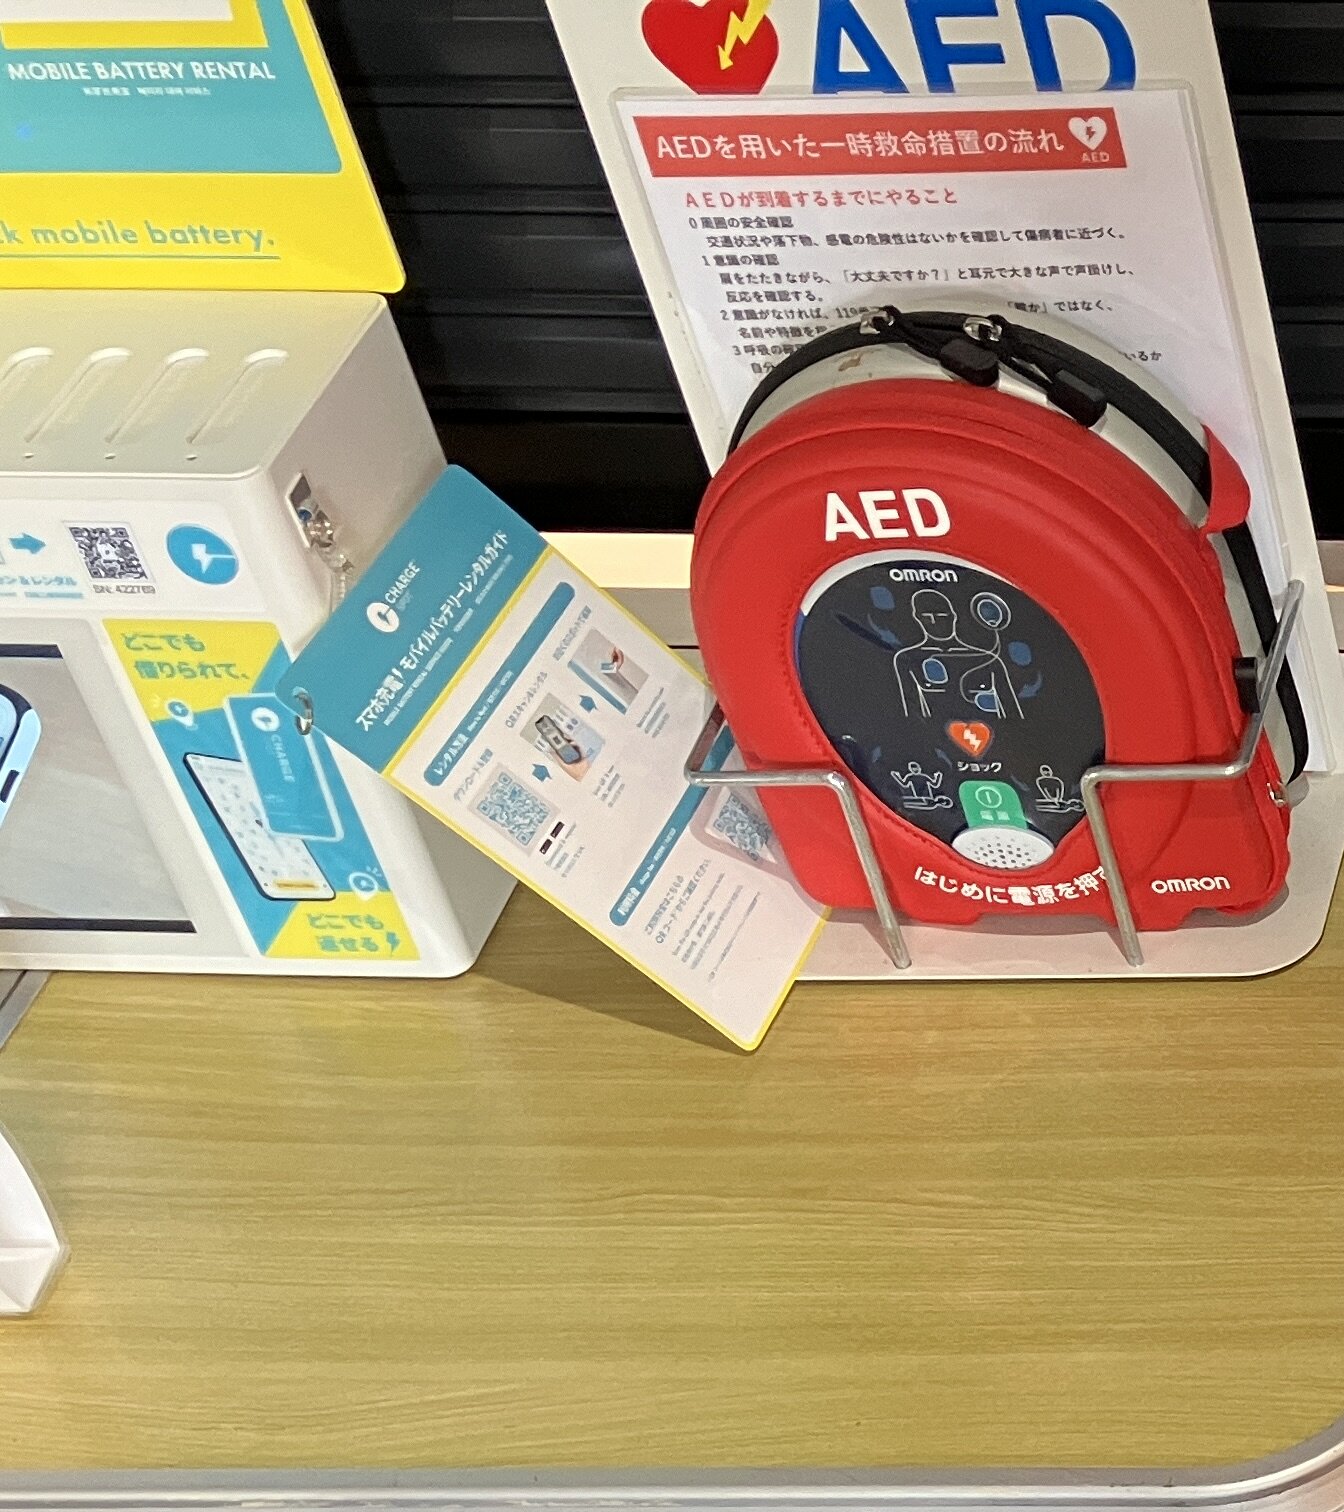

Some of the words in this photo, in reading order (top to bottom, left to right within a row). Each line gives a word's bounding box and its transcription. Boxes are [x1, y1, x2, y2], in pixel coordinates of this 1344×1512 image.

[813, 0, 1136, 94] AED
[8, 62, 91, 80] MOBILE
[92, 62, 184, 79] BATTERY
[191, 61, 276, 79] RENTAL
[657, 128, 1065, 159] AEDを用いた一時救命措置の流れ
[1081, 152, 1110, 163] AED
[0, 220, 23, 243] k
[31, 220, 138, 244] mobile
[145, 220, 274, 252] battery.
[825, 488, 951, 541] AED
[383, 560, 420, 605] CHARGE
[889, 568, 958, 583] OMRON
[120, 632, 205, 652] どこでも
[957, 761, 1002, 773] ショック
[1151, 875, 1231, 894] OMRON
[307, 913, 384, 930] どこでも
